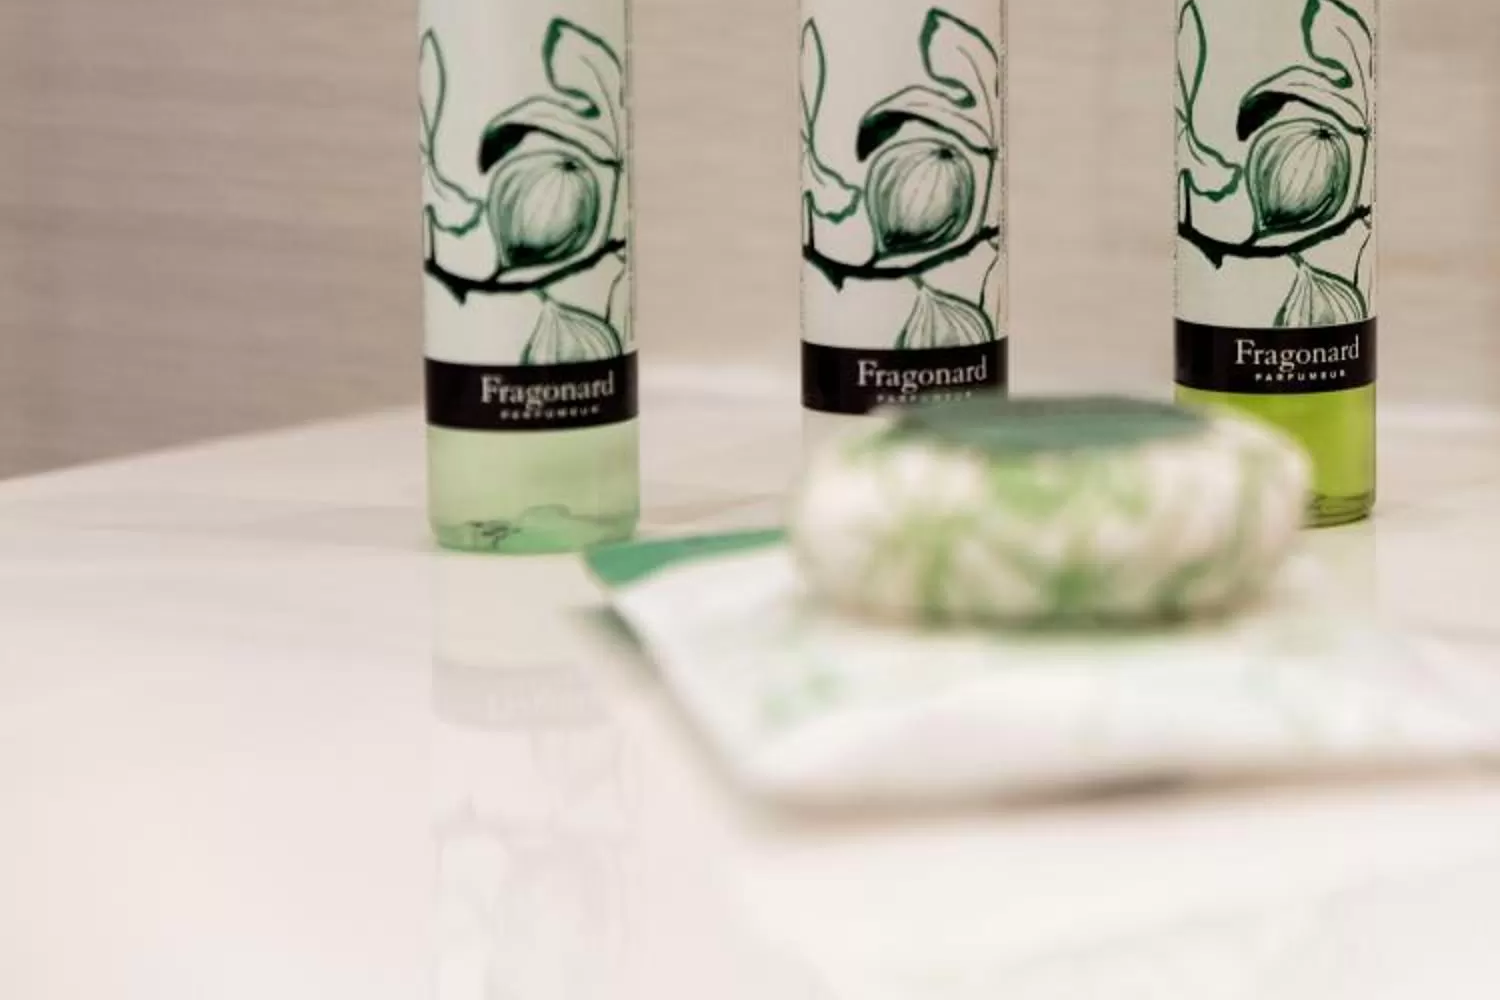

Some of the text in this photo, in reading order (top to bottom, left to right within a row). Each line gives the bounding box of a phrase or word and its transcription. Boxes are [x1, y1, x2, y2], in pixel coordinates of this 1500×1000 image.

[1235, 334, 1360, 373] Fragonard
[481, 369, 615, 412] Fragonard
[858, 354, 988, 394] Fragonard
[1255, 369, 1347, 382] PARFUMEUR
